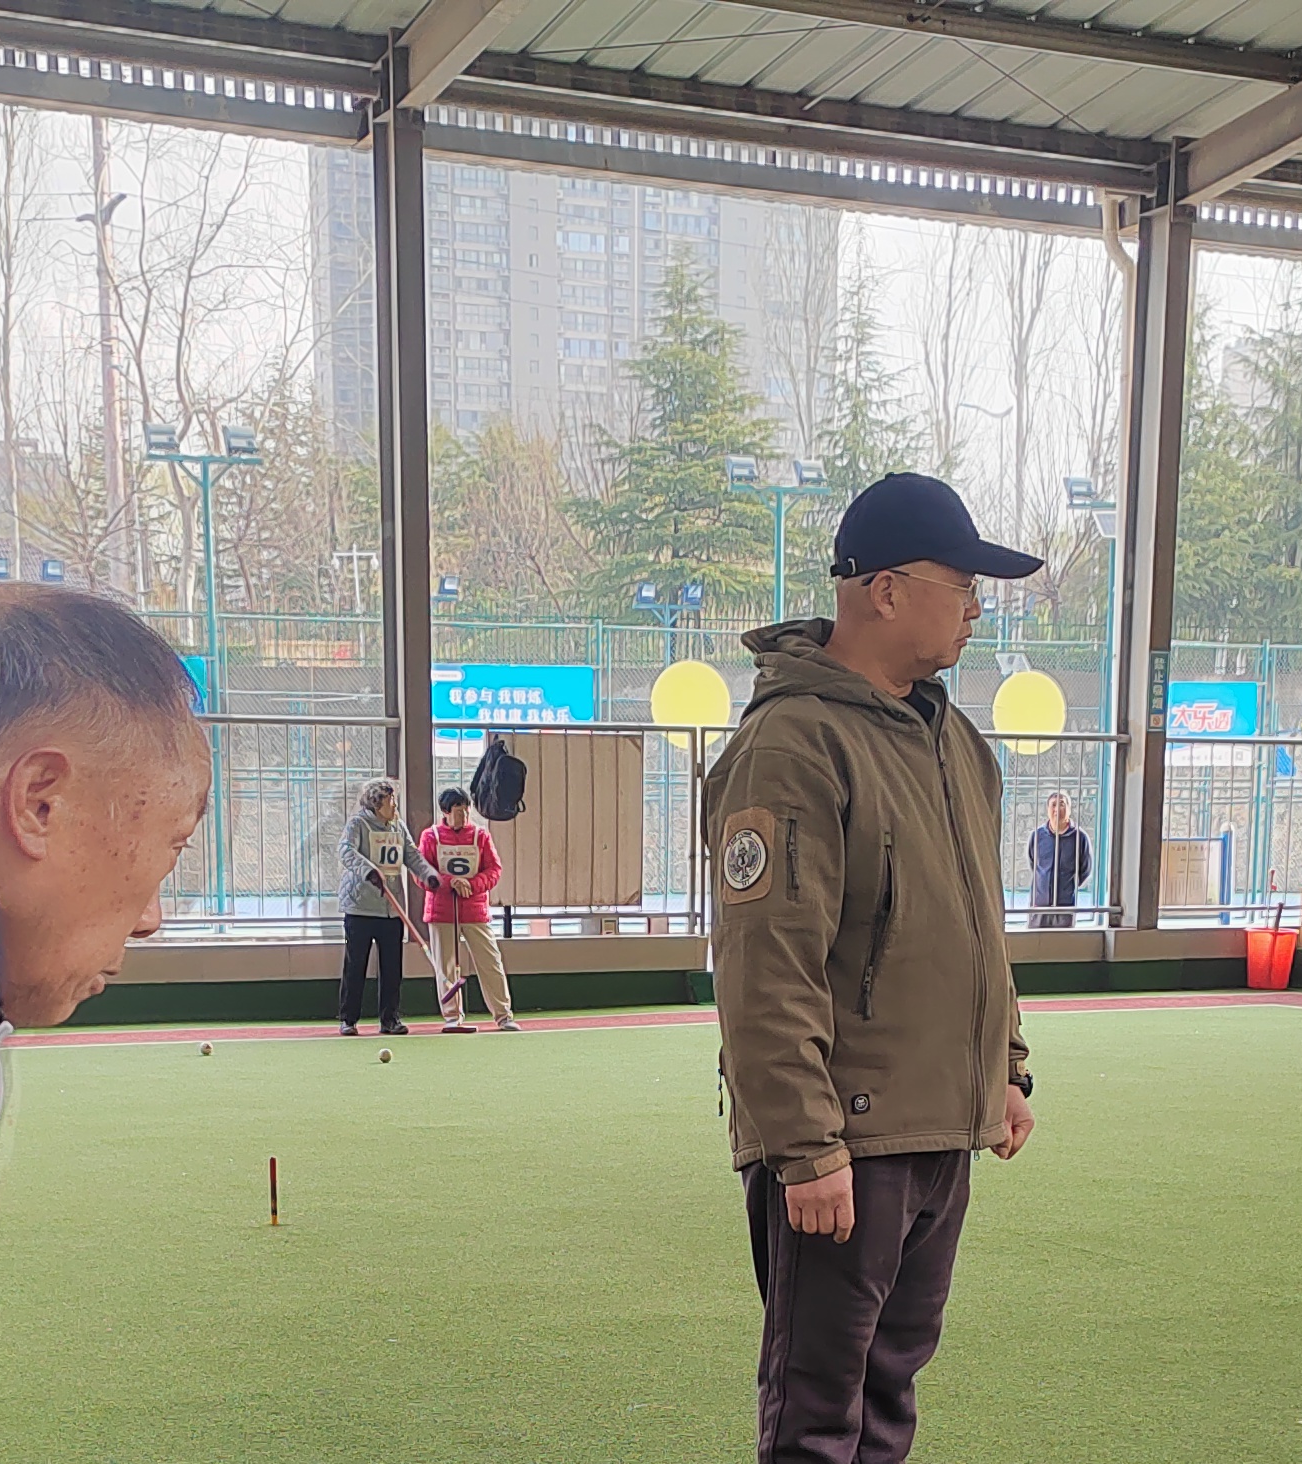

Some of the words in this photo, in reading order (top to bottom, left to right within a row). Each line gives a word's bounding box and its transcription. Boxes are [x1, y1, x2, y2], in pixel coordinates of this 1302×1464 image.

[450, 688, 493, 705] 我参与
[498, 688, 543, 705] 我锻炼
[478, 707, 523, 723] 我健康
[527, 707, 570, 723] 我快乐
[1171, 702, 1233, 732] 大乐透
[379, 845, 399, 865] 10
[446, 857, 470, 876] 6
